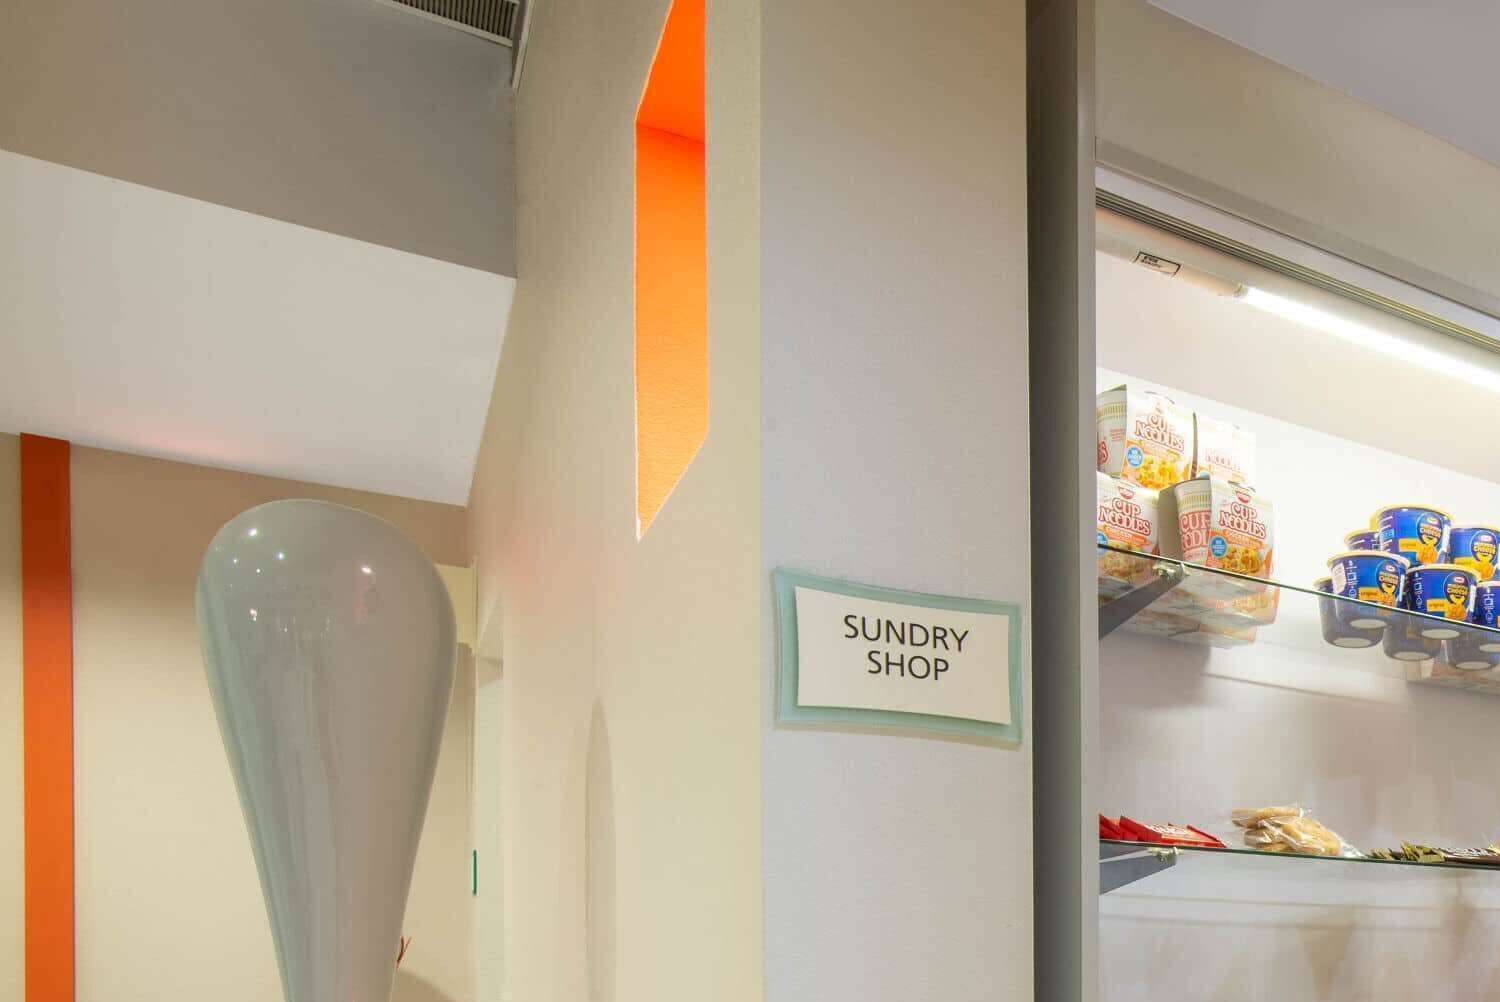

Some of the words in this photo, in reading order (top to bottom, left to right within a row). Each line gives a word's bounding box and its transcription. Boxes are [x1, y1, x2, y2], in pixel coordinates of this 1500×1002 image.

[1098, 507, 1152, 536] NOODLES
[1112, 498, 1142, 517] CUP
[1231, 502, 1258, 520] CUP
[1218, 511, 1267, 540] NOODLES
[844, 614, 969, 653] SUNDRY
[867, 650, 949, 681] SHOP
